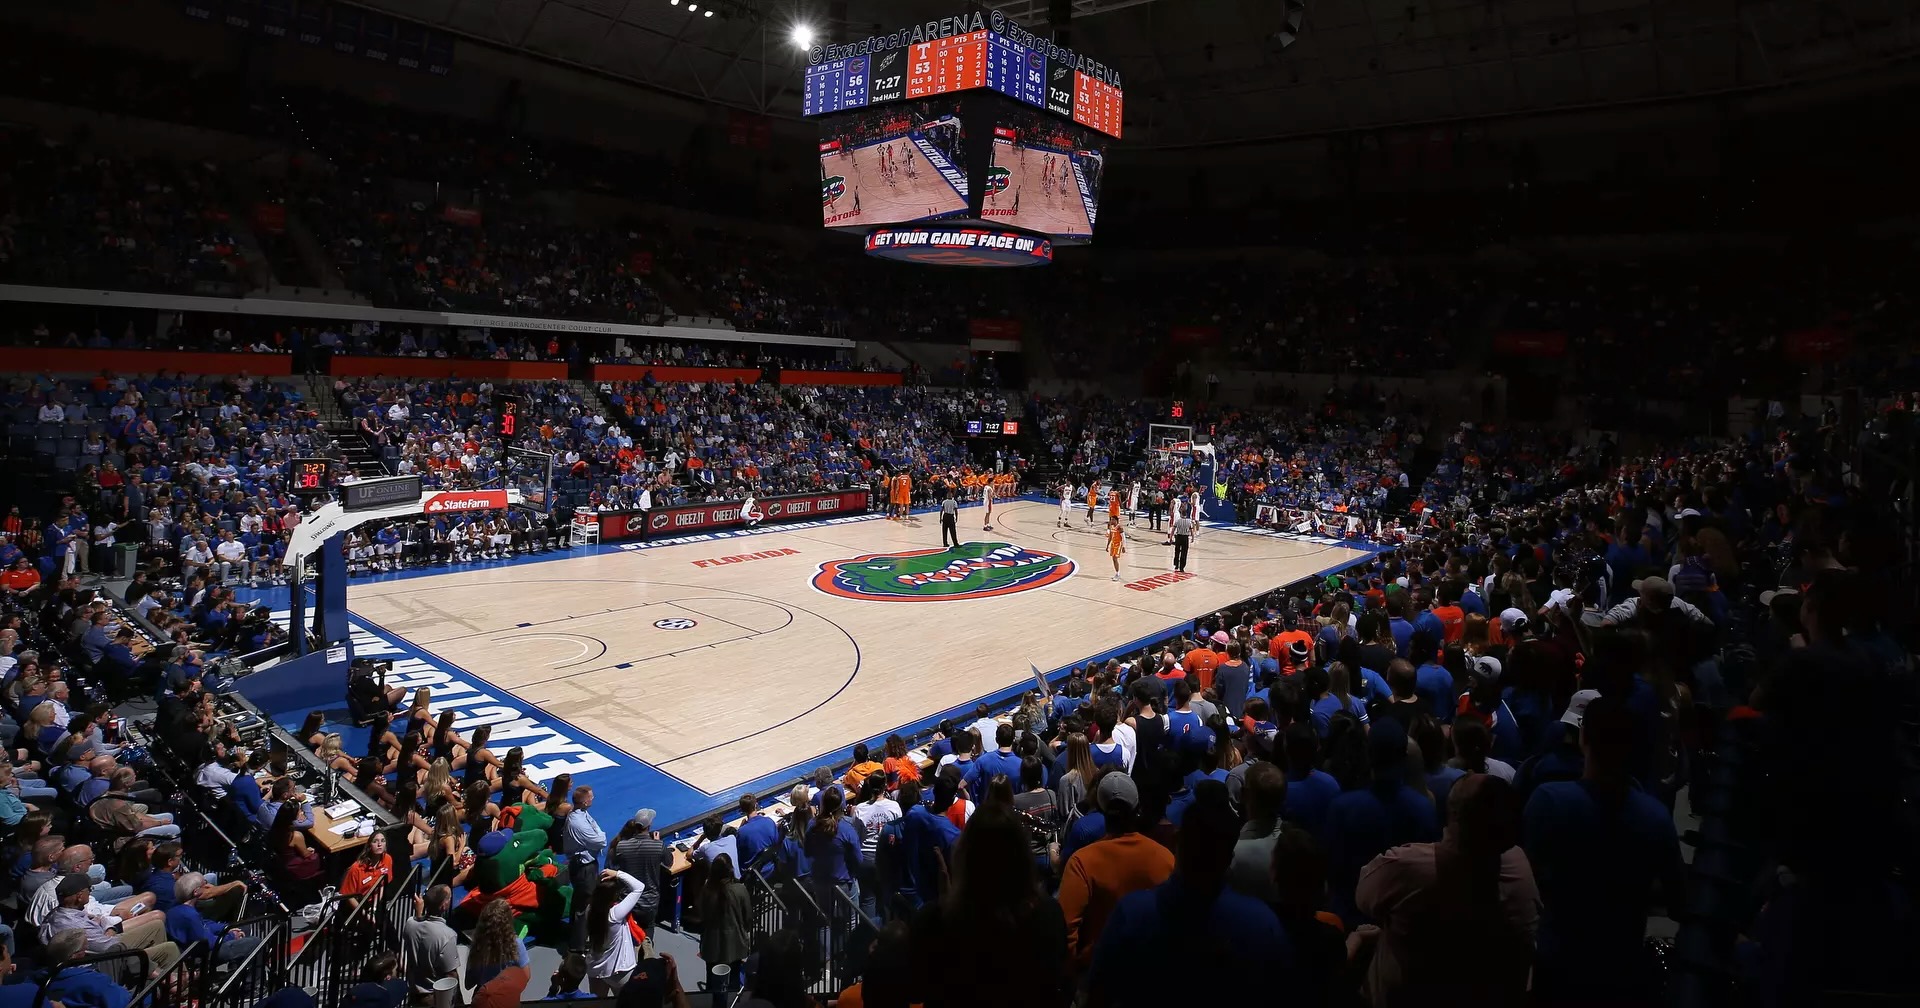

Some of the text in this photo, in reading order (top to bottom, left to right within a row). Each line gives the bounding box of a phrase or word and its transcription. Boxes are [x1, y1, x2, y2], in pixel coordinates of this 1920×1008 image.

[909, 10, 985, 45] ARENA
[917, 44, 930, 59] T
[999, 37, 1010, 46] PTS
[1014, 43, 1024, 53] FLS
[915, 62, 930, 74] 53
[1075, 54, 1122, 90] ARENA
[849, 75, 863, 86] 56
[875, 75, 900, 90] 7:27
[1028, 70, 1040, 83] 56
[1081, 74, 1089, 90] T
[1025, 83, 1035, 91] FLS
[883, 92, 900, 101] HALF
[1026, 93, 1036, 102] TOL
[1050, 87, 1070, 104] 7:27
[1080, 92, 1089, 104] 53
[1076, 114, 1086, 122] TOL
[824, 210, 860, 224] GATORS
[874, 232, 1034, 252] GET YOUR GAME FACE ON!
[1171, 407, 1182, 417] 30
[501, 415, 514, 434] 30
[304, 463, 325, 473] 7:27
[302, 474, 318, 488] 30
[359, 484, 410, 498] UF ONLINE
[310, 520, 336, 541] SPALDING
[620, 534, 713, 550] STEPHEN
[826, 514, 886, 524] CENTER
[691, 548, 802, 568] FLORIDA
[1124, 571, 1198, 591] GATORS
